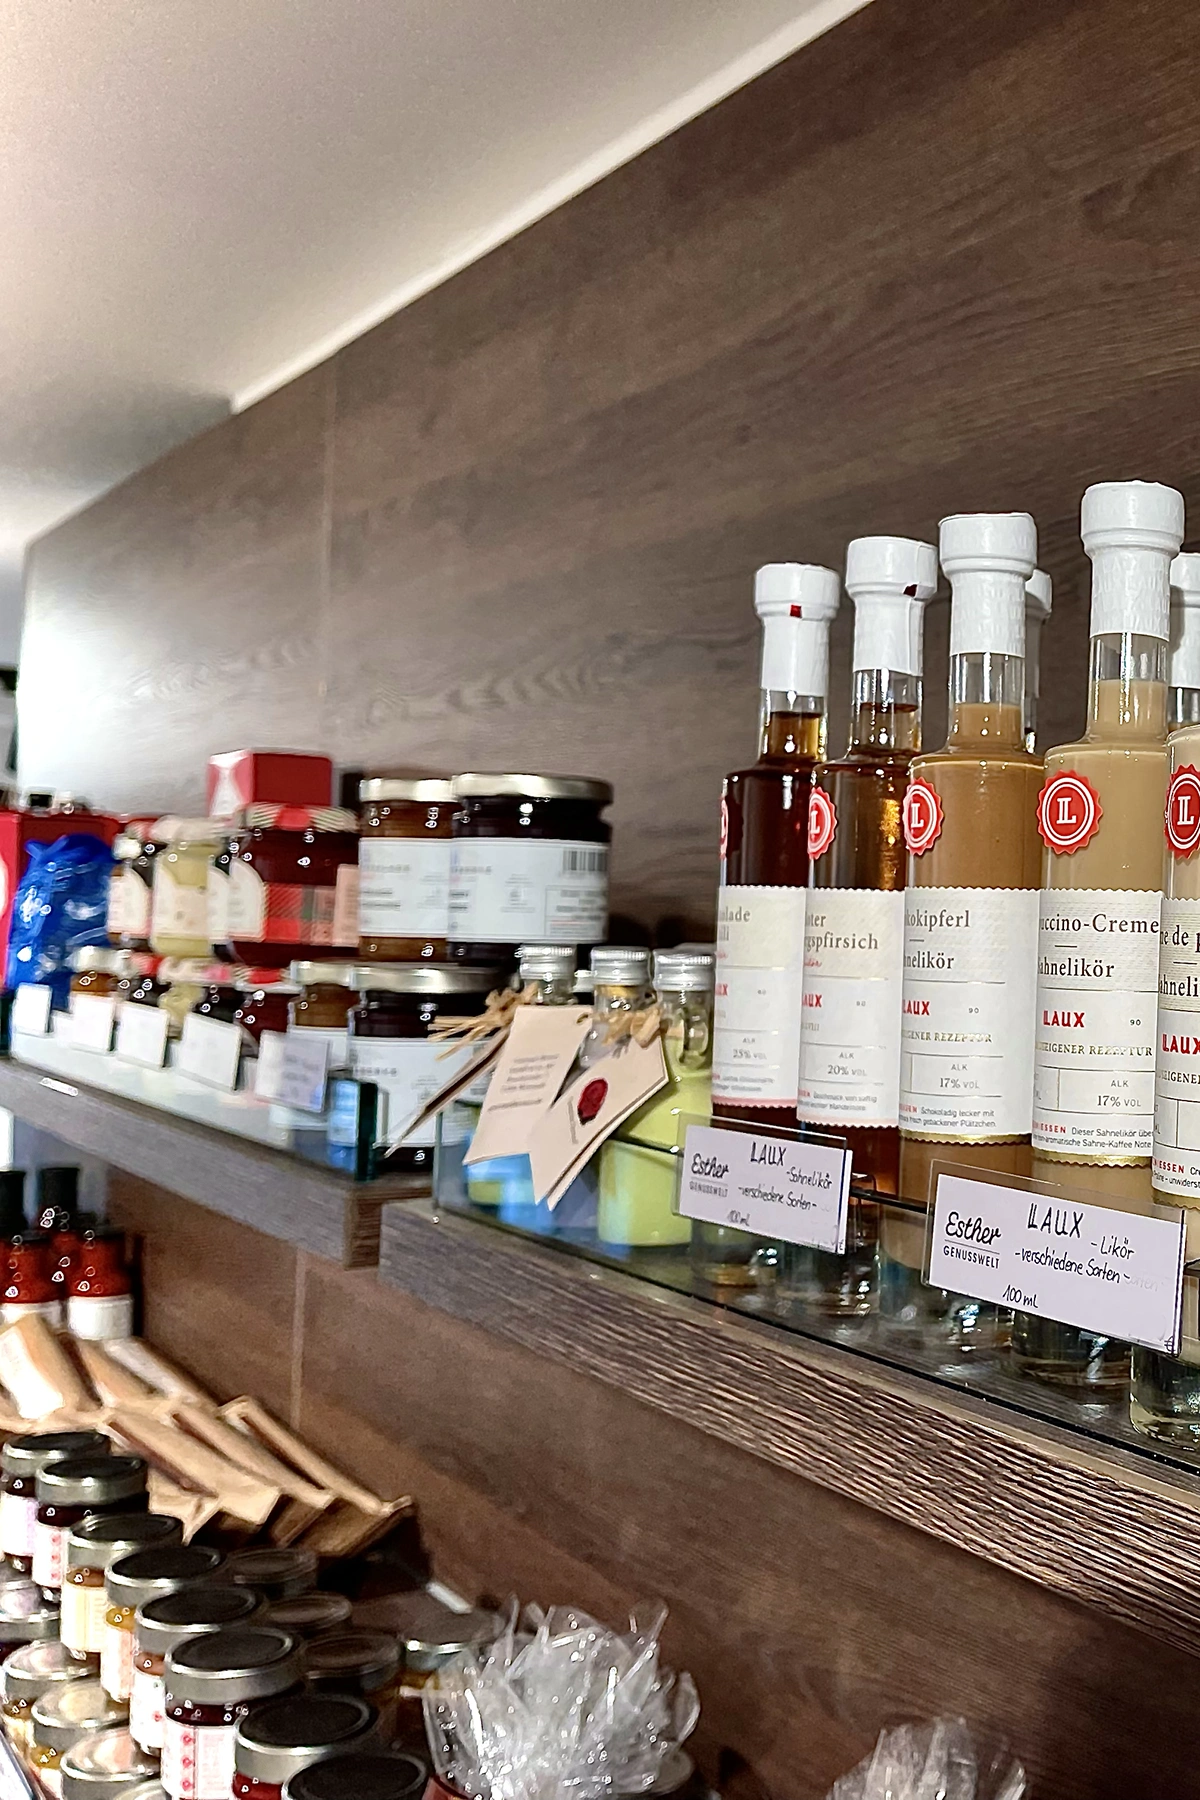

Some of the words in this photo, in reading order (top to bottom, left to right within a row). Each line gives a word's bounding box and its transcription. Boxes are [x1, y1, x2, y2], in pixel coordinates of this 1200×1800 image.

[1172, 925, 1189, 946] de
[1038, 956, 1115, 979] ahnelikör
[1130, 1018, 1142, 1026] 90
[950, 1063, 968, 1071] ALK
[939, 1077, 961, 1089] 17%
[1110, 1079, 1129, 1088] ALK
[1097, 1094, 1121, 1108] 17%
[1124, 1098, 1142, 1108] VOL
[1071, 1125, 1095, 1137] Dieser
[750, 1141, 787, 1167] LAUX
[691, 1153, 729, 1180] Esther
[689, 1180, 729, 1198] GENUSSWELT
[945, 1211, 1001, 1246] Esther
[943, 1245, 1000, 1269] GENUSSWELT
